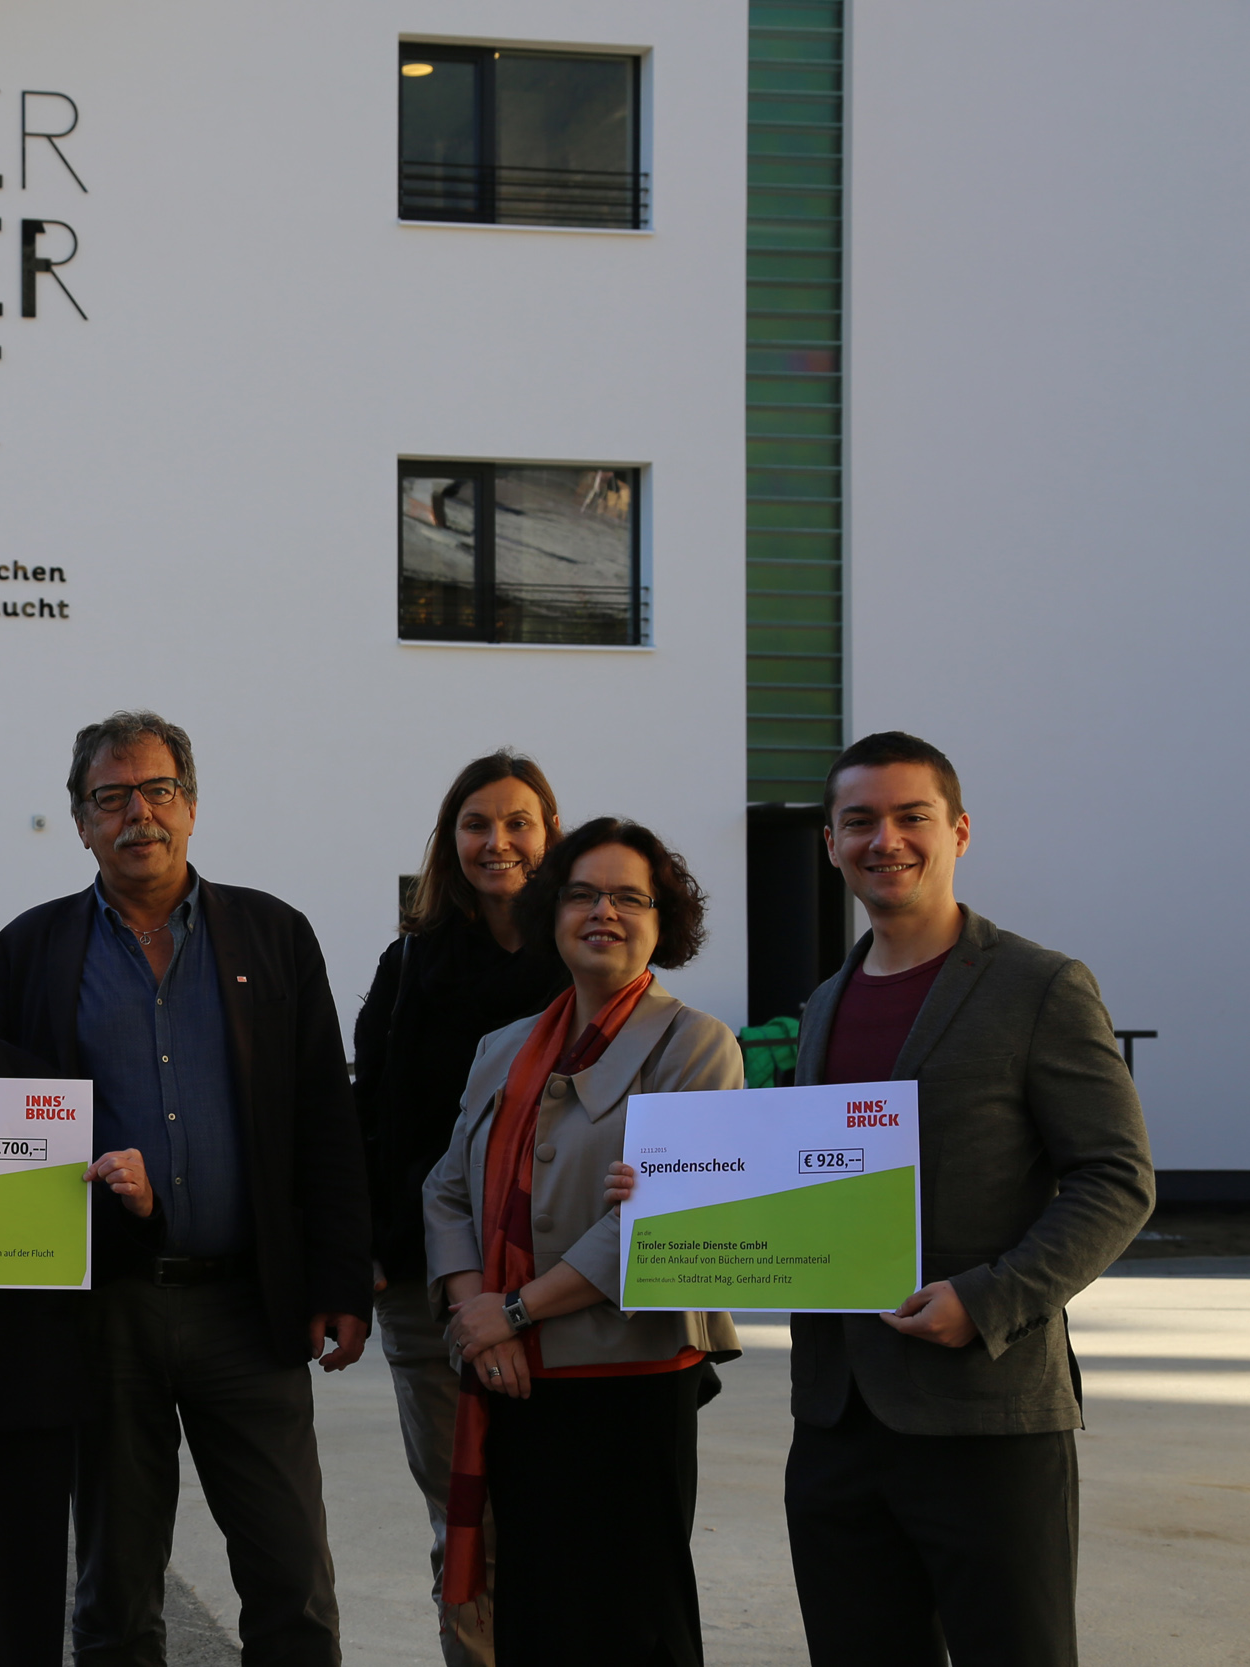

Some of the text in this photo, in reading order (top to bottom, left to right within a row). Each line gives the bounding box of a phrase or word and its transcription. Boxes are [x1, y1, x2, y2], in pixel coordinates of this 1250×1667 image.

[25, 1108, 76, 1120] BRUCK
[847, 1114, 899, 1128] BRUCK
[640, 1158, 745, 1177] Spendenscheck
[637, 1241, 768, 1250] Tiroler Soziale Dienste GmbH
[4, 1249, 15, 1258] auf
[17, 1249, 29, 1258] der
[31, 1249, 54, 1258] Flucht
[637, 1255, 648, 1264] für
[650, 1255, 666, 1264] den
[668, 1255, 698, 1264] Ankauf
[718, 1255, 754, 1264] Büchern
[756, 1255, 773, 1264] und
[776, 1255, 830, 1264] Lernmaterial
[678, 1274, 712, 1284] Stadtrat
[714, 1274, 734, 1285] Mag.
[736, 1274, 770, 1284] Gerhard
[773, 1274, 792, 1284] Fritz
